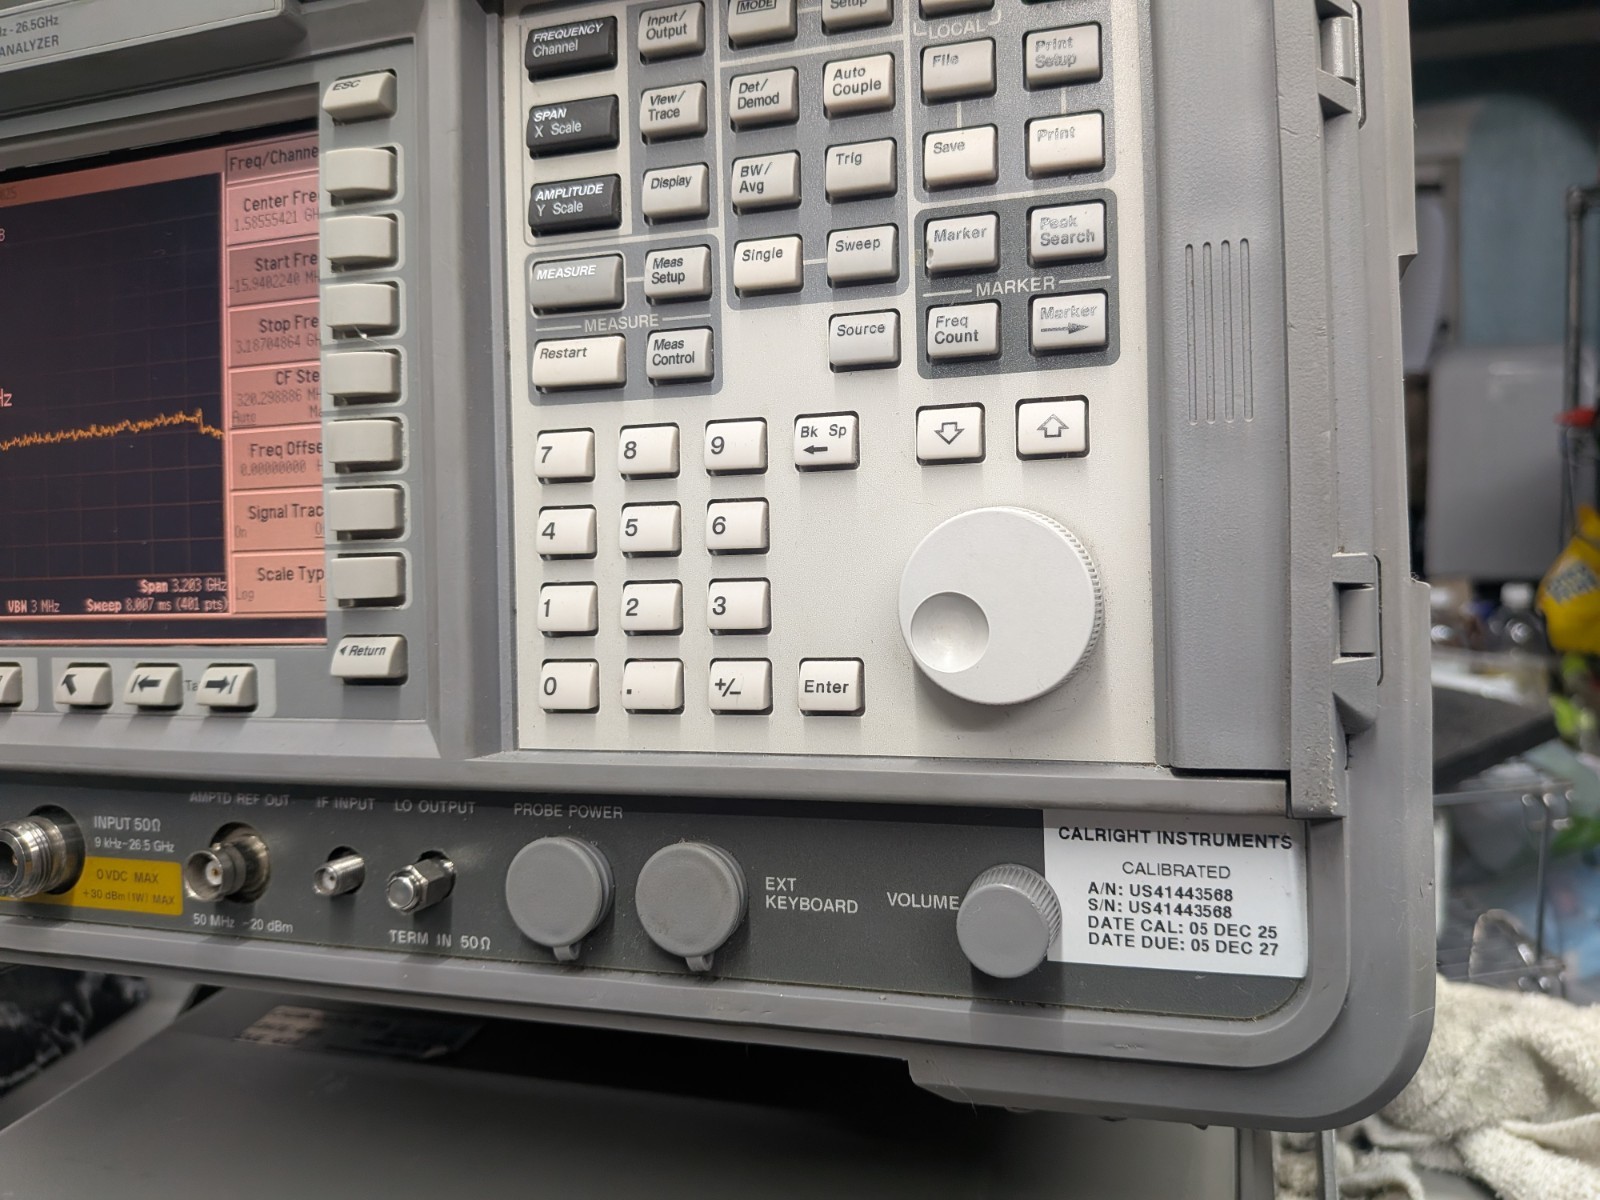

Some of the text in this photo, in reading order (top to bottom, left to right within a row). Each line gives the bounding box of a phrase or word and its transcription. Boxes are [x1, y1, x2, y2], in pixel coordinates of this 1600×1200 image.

[740, 0, 775, 12] MODE
[15, 15, 59, 34] 26.5GHz
[647, 10, 687, 26] Input/
[533, 23, 604, 43] FREQUENCY
[646, 24, 687, 40] Output
[929, 19, 986, 39] LOCAL
[0, 34, 59, 57] ANALYZER
[532, 40, 579, 58] Channel
[1035, 36, 1074, 52] Print
[932, 54, 960, 67] File
[1035, 53, 1077, 69] Setup
[833, 67, 866, 81] Auto
[332, 79, 362, 91] ESC
[738, 78, 769, 95] Det/
[832, 78, 882, 96] Couple
[650, 91, 686, 106] View/
[737, 92, 780, 110] Demod
[534, 108, 567, 123] SPAN
[648, 108, 680, 122] Trace
[534, 121, 582, 138] X Scale
[1037, 126, 1076, 142] Print
[933, 139, 966, 154] Save
[836, 152, 862, 166] Trig
[740, 162, 772, 178] BW/
[651, 175, 692, 190] Display
[739, 180, 765, 194] Avg
[536, 184, 604, 201] AMPLITUDE
[243, 190, 319, 212] Center Fre
[537, 201, 584, 217] Y Scale
[234, 210, 297, 232] 1.58555421
[1040, 215, 1077, 230] Peak
[933, 226, 988, 243] Marker
[1040, 229, 1095, 247] Search
[835, 238, 881, 253] Sweep
[742, 247, 783, 262] Single
[255, 254, 290, 272] Start
[652, 257, 684, 270] Meas
[536, 265, 596, 281] MEASURE
[651, 270, 686, 285] Setup
[976, 276, 1055, 297] MARKER
[1040, 305, 1097, 320] Marker
[259, 317, 291, 334] Stop
[584, 314, 659, 333] MEASURE
[837, 322, 886, 337] Source
[935, 315, 969, 329] Freq
[653, 338, 684, 351] Meas
[934, 329, 979, 344] Count
[539, 347, 587, 359] Restart
[652, 351, 695, 366] Control
[275, 370, 292, 385] CF
[800, 424, 847, 439] Bk Sp
[250, 443, 283, 459] Freq
[623, 441, 637, 459] 8
[710, 436, 725, 455] 9
[541, 445, 553, 464] 7
[249, 505, 288, 522] Signal
[235, 525, 247, 538] On
[541, 521, 556, 540] 4
[624, 518, 638, 537] 5
[712, 516, 727, 535] 6
[257, 567, 294, 581] Scale
[139, 579, 168, 595] Span
[205, 577, 227, 591] GHz
[235, 586, 254, 602] Log
[31, 600, 38, 613] 3
[41, 600, 60, 613] MHz
[86, 598, 122, 613] Sweep
[157, 600, 172, 611] ms
[543, 598, 551, 617] 1
[625, 598, 639, 616] 2
[712, 596, 727, 615] 3
[349, 645, 387, 656] Return
[543, 676, 557, 695] 0
[804, 679, 850, 694] Enter
[190, 792, 290, 806] AMPTD REF OUT
[316, 796, 376, 810] IF INPUT
[394, 799, 476, 814] LO OUTPUT
[514, 803, 623, 819] PROBE POWER
[94, 815, 131, 830] INPUT
[94, 836, 101, 848] 9
[153, 840, 175, 853] GHz
[1058, 826, 1293, 850] CALRIGHT INSTRUMENTS
[134, 871, 159, 884] MAX
[1122, 861, 1231, 879] CALIBRATED
[765, 877, 797, 892] EXT
[1088, 881, 1233, 902] A/N: US41443568
[105, 890, 126, 901] dBm
[152, 893, 176, 905] MAX
[765, 895, 858, 914] KEYBOARD
[886, 891, 960, 911] VOLUME
[1088, 898, 1232, 919] S/N: US41443568
[193, 912, 207, 925] 50
[210, 914, 235, 928] MHz
[267, 919, 293, 933] dBm
[1087, 915, 1278, 939] DATE CAL: 05 DEC 25
[389, 929, 428, 945] TERM
[436, 932, 452, 947] IN
[1088, 932, 1279, 956] DATE DUE: 05 DEC 27
